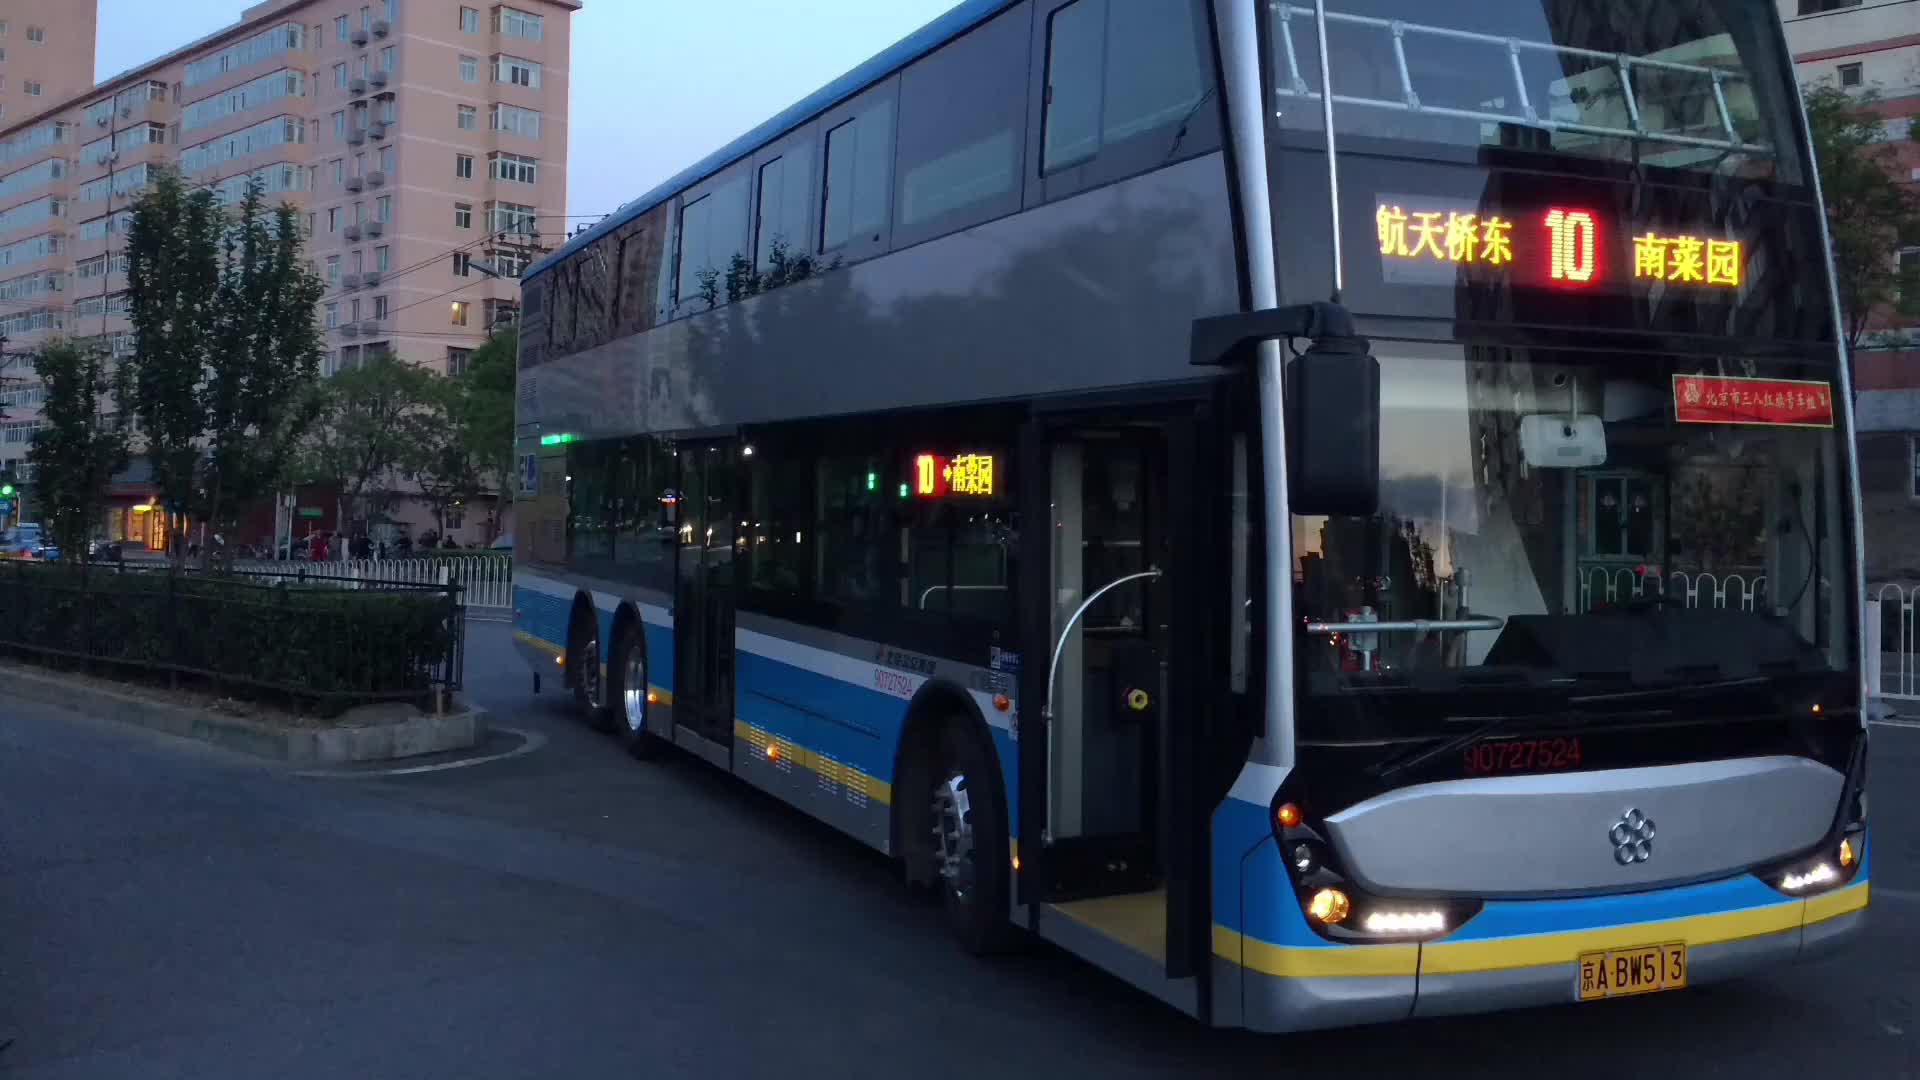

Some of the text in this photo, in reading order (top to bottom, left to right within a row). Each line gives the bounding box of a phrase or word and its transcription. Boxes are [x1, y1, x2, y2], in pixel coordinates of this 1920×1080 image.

[1376, 204, 1512, 264] 航天桥东
[1545, 209, 1596, 282] 10
[1634, 233, 1741, 286] 南菜园
[917, 455, 934, 494] 10
